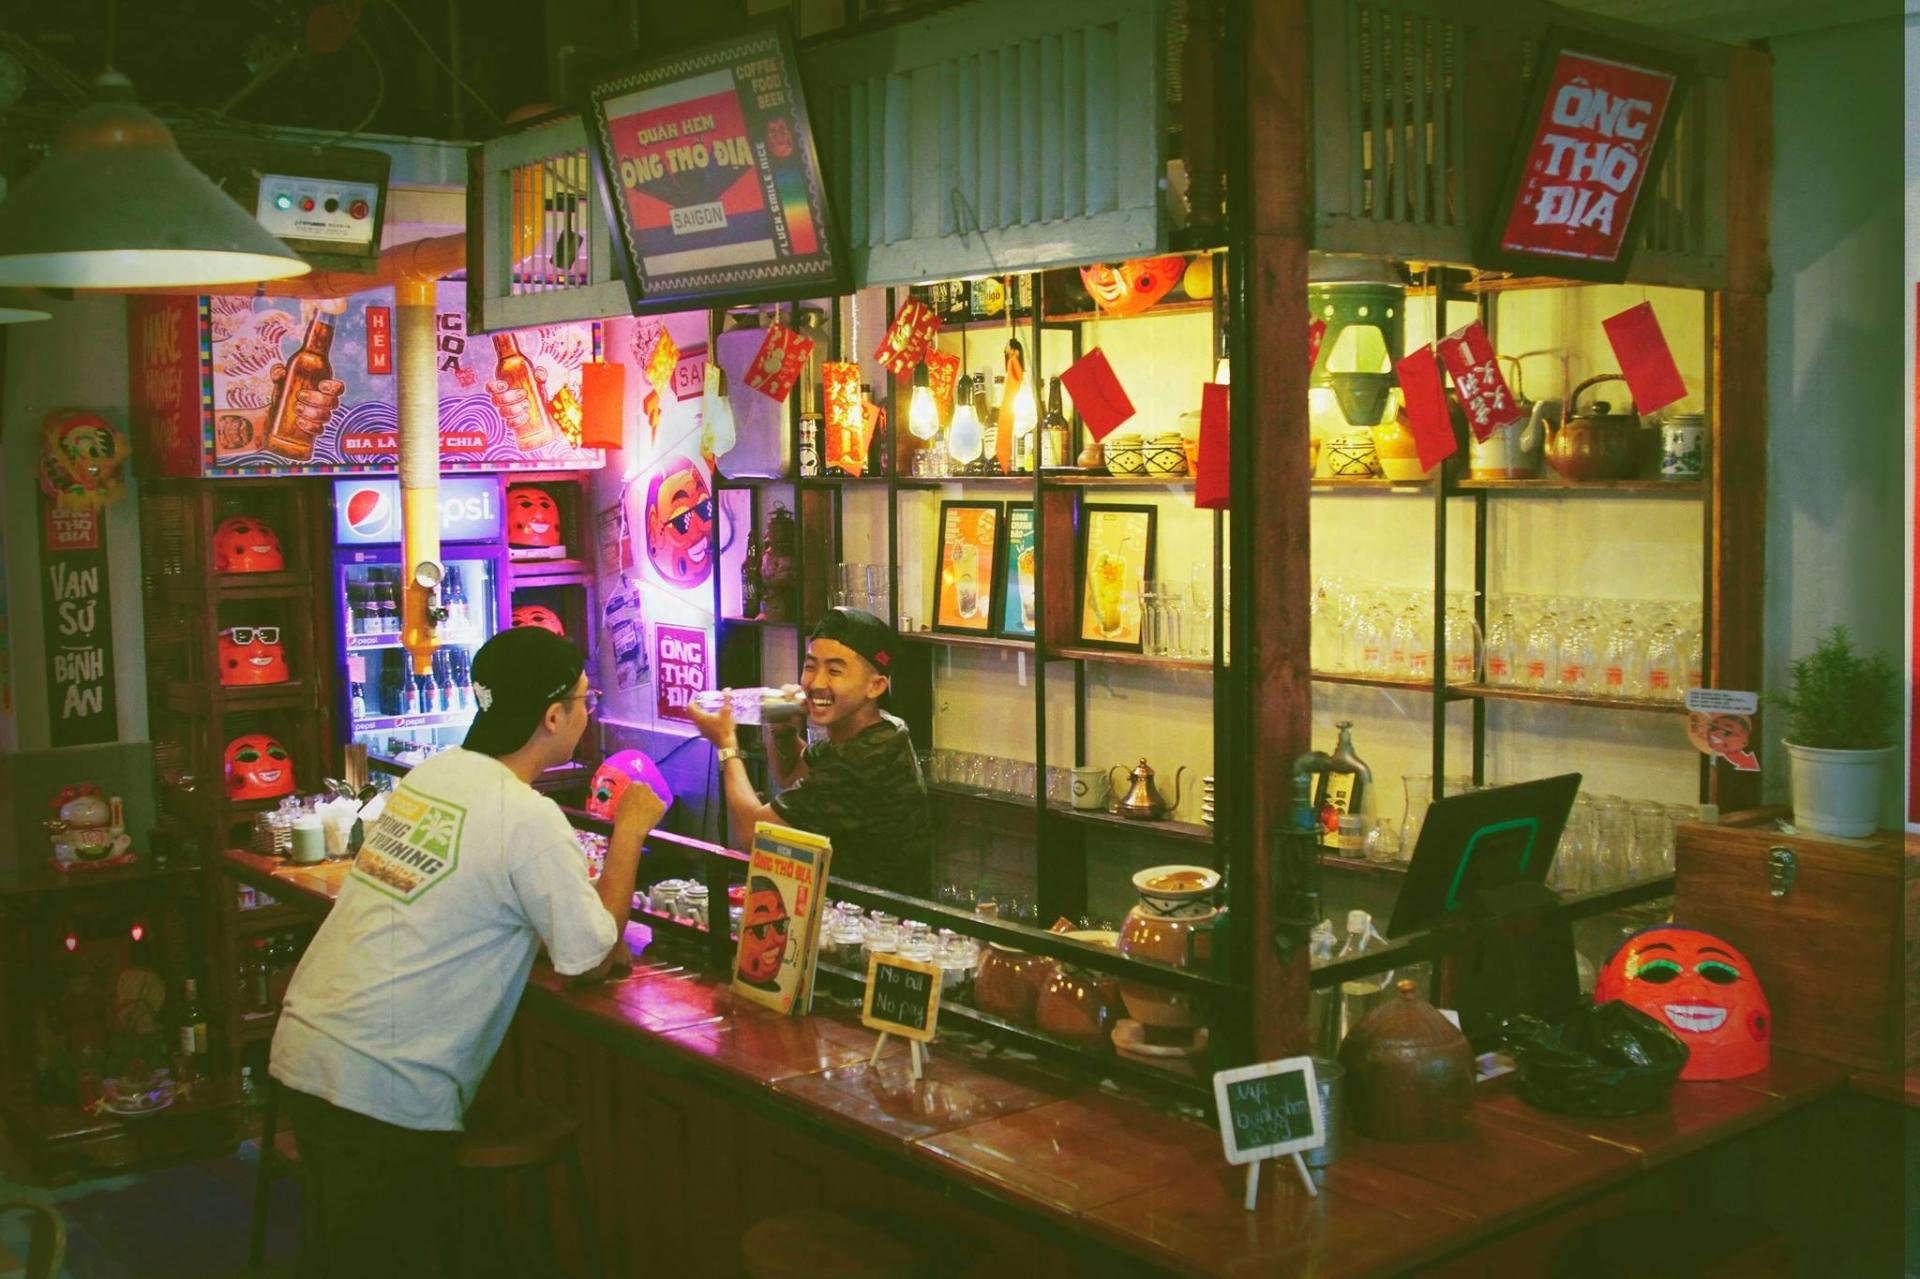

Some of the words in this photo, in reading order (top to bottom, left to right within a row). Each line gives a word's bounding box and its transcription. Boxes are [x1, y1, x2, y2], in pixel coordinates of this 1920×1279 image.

[673, 207, 723, 230] SAIGON
[1534, 185, 1618, 235] ĐỊA
[680, 361, 705, 387] SAI
[346, 438, 371, 449] BIA
[446, 437, 483, 447] CHIA
[442, 491, 491, 528] psi
[58, 599, 97, 637] SỰ
[660, 634, 701, 661] ÔNG
[62, 684, 103, 719] AN
[354, 722, 376, 731] pepsi
[404, 717, 426, 726] pepsi
[881, 966, 900, 984] No
[877, 992, 896, 1013] No
